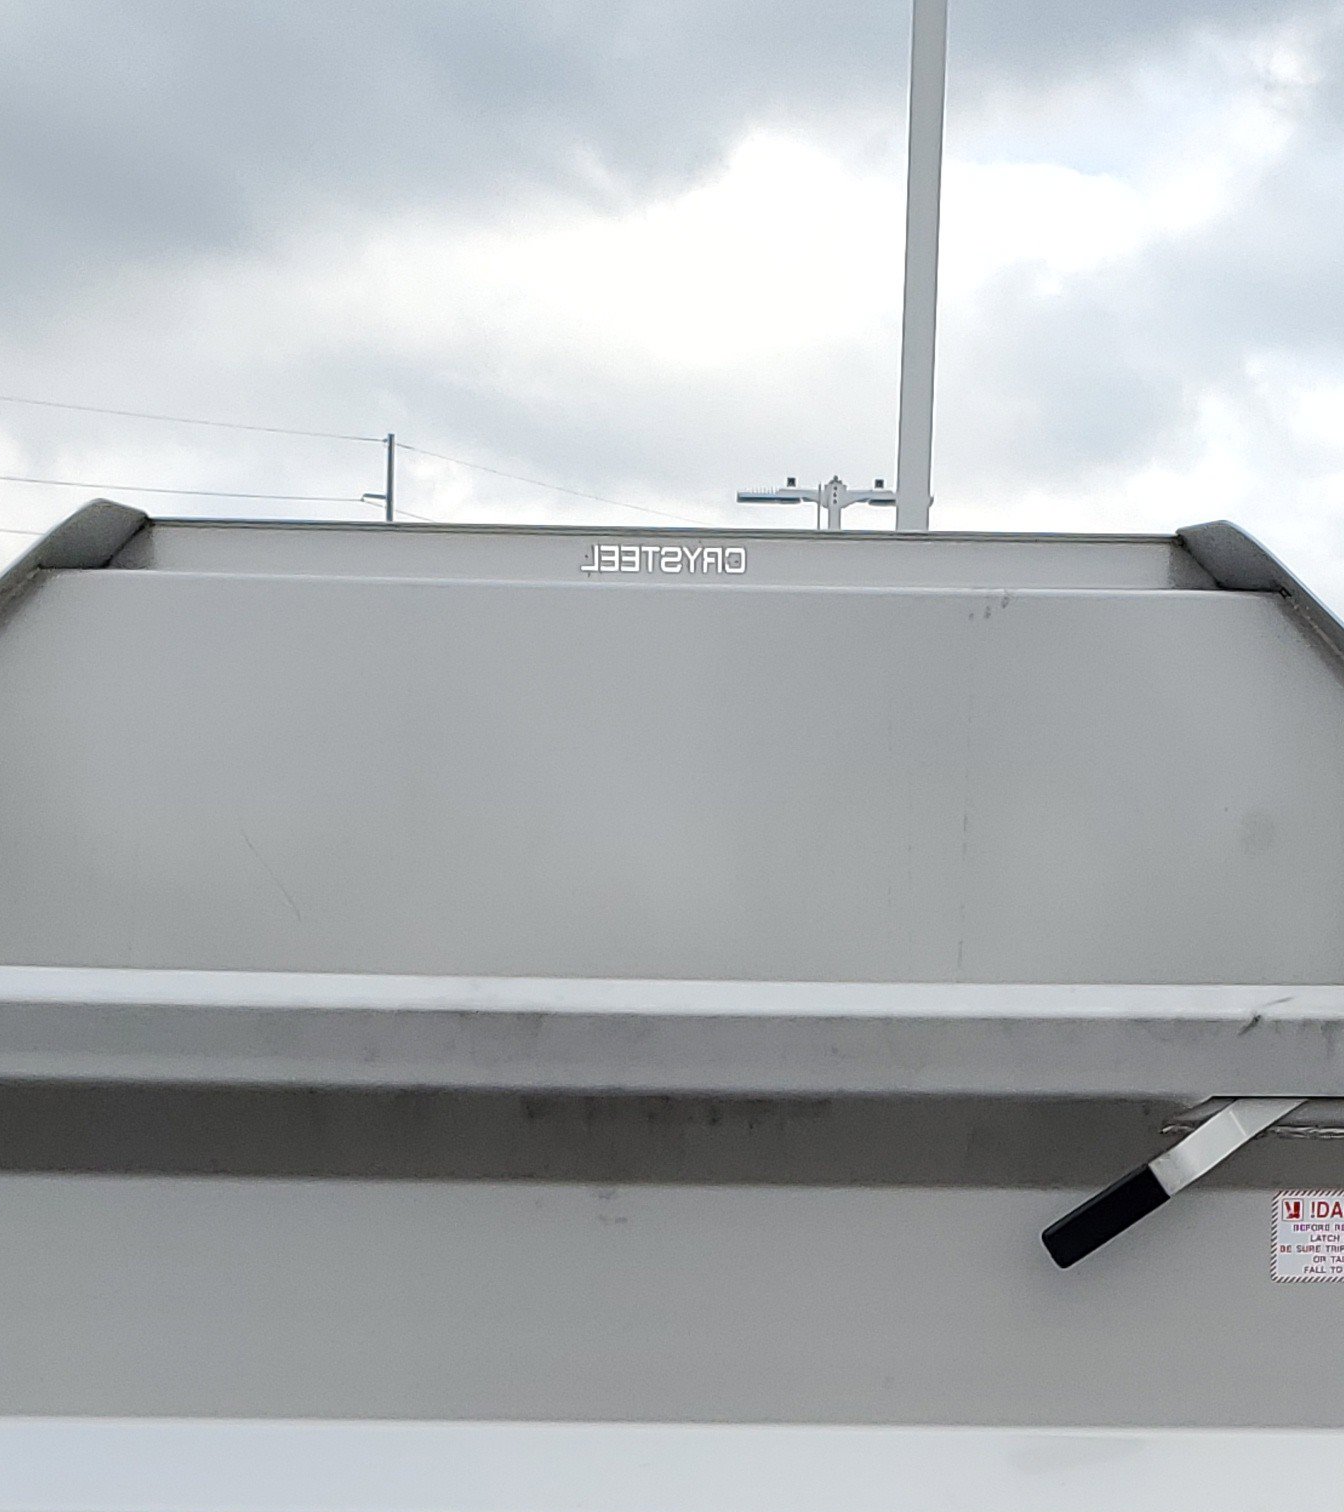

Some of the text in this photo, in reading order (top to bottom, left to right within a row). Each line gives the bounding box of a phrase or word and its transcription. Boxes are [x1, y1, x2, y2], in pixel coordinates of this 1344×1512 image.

[1293, 1223, 1330, 1232] BEFORE
[1310, 1233, 1340, 1243] LATCH
[1280, 1244, 1292, 1253] BE
[1296, 1244, 1321, 1253] SURE
[1312, 1255, 1327, 1263] OR
[1303, 1265, 1326, 1274] FALL
[1330, 1265, 1343, 1274] TO
